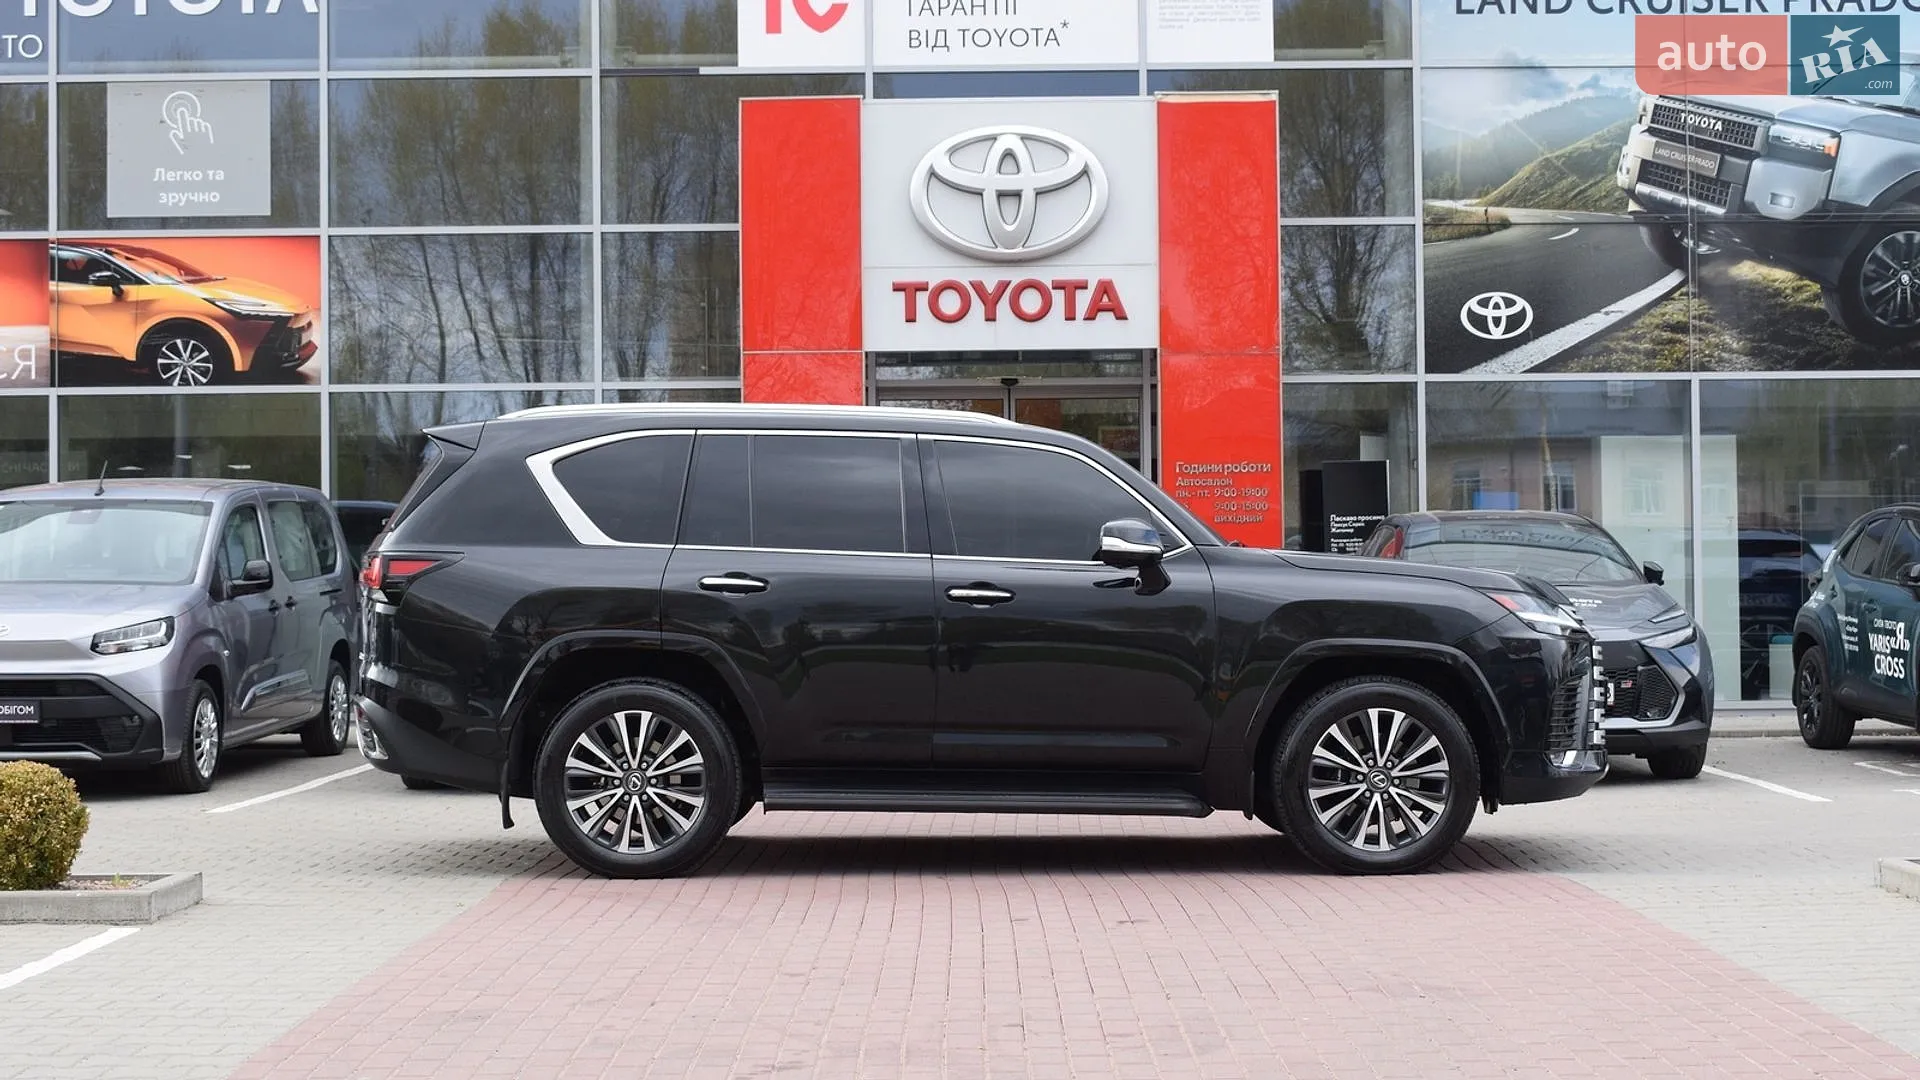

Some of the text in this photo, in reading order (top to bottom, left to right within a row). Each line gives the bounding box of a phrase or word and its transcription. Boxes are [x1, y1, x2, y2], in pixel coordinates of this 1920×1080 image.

[908, 29, 950, 52] ВІД
[1680, 112, 1723, 132] TOYOTA
[1654, 147, 1670, 158] LAND
[1695, 157, 1715, 169] PRADO
[153, 167, 225, 181] Легко та
[159, 191, 220, 206] зручно
[892, 278, 1129, 323] TOYOTA
[1175, 461, 1271, 475] Години роботи
[1175, 477, 1233, 486] Автосалон
[1214, 512, 1264, 523] вихідний
[1868, 632, 1891, 654] YARIS
[1874, 653, 1905, 679] CROSS
